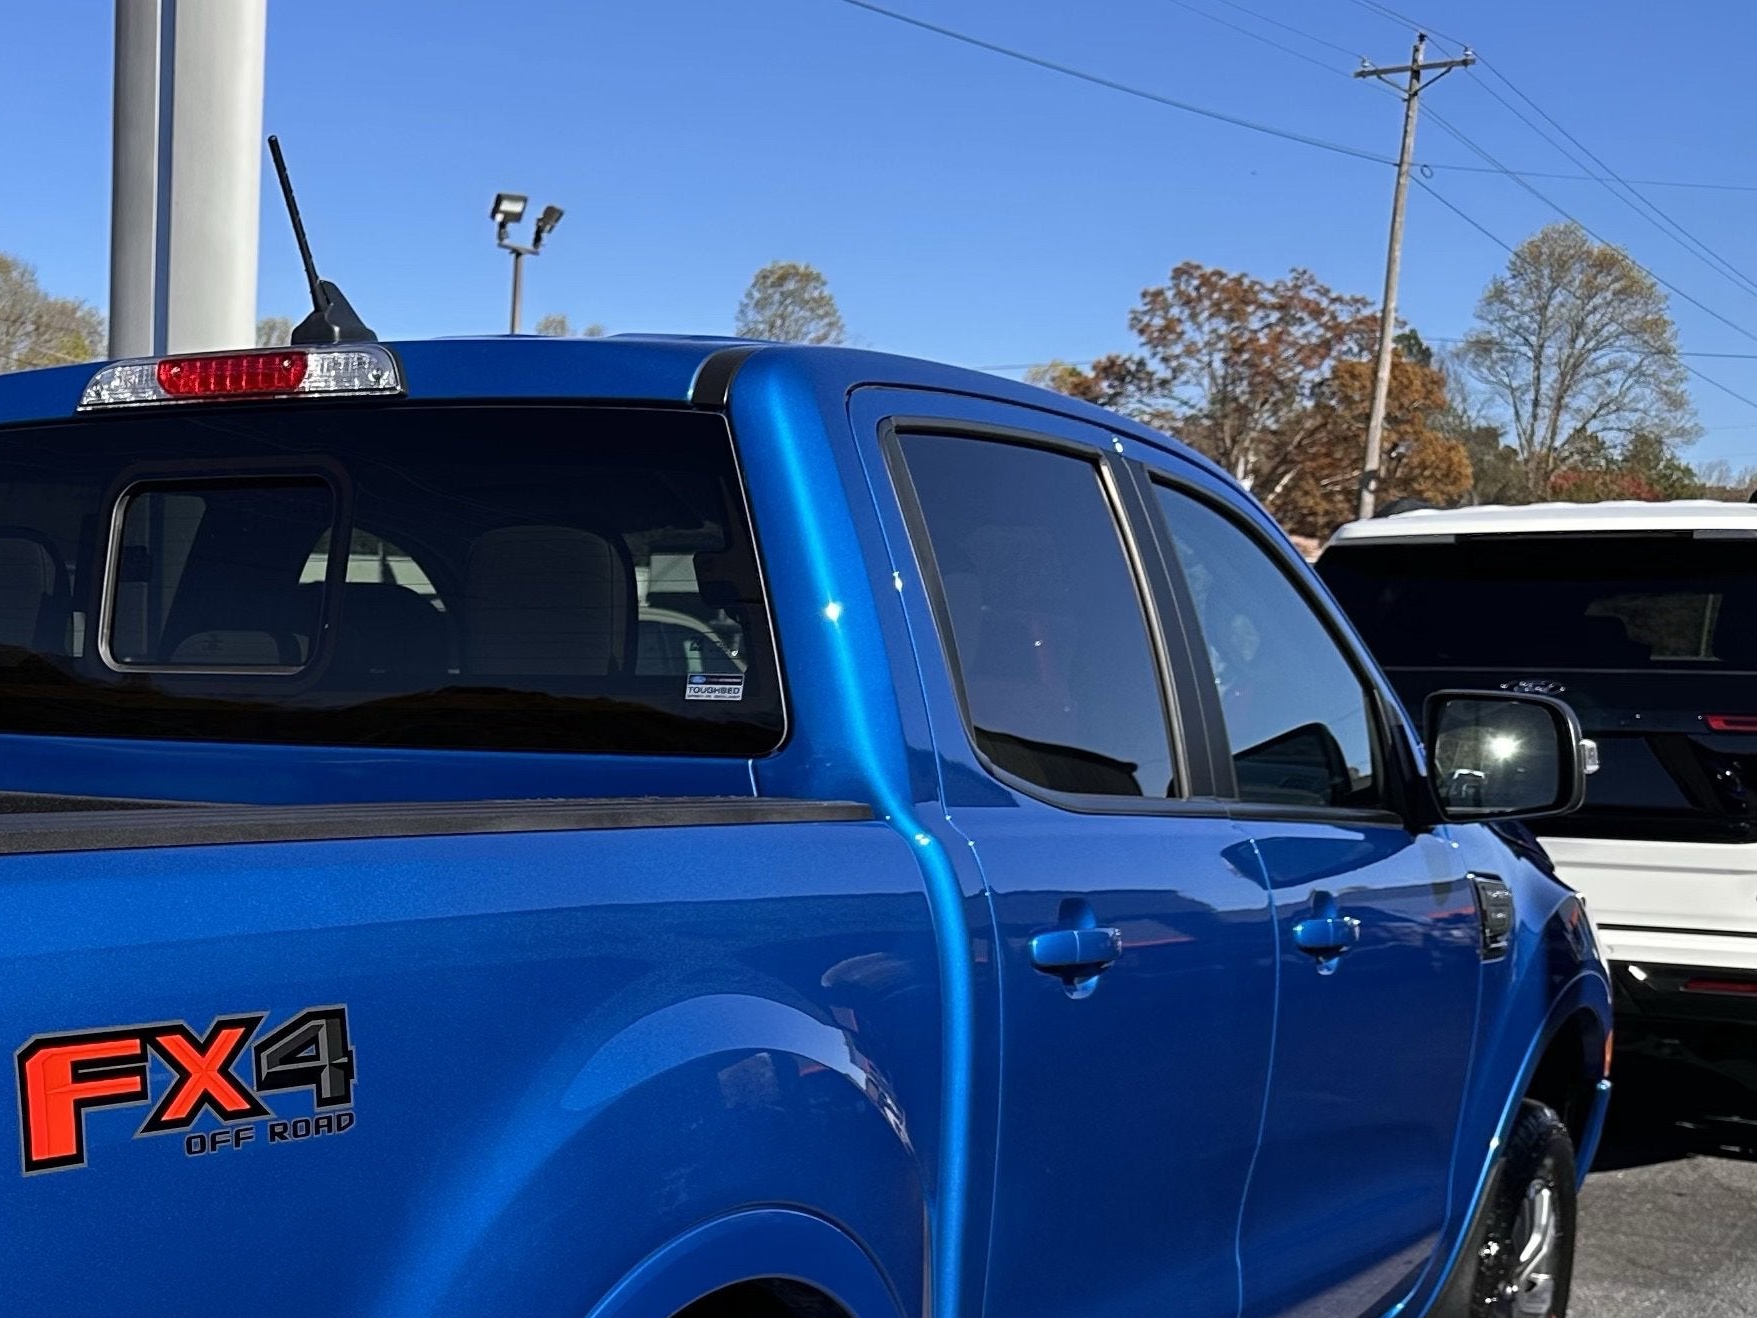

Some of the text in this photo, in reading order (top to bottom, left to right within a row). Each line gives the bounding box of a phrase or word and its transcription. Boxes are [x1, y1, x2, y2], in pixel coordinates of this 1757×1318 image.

[687, 686, 741, 695] TOUGHBED
[14, 1003, 358, 1178] FX4
[185, 1111, 356, 1157] OFF ROAD
